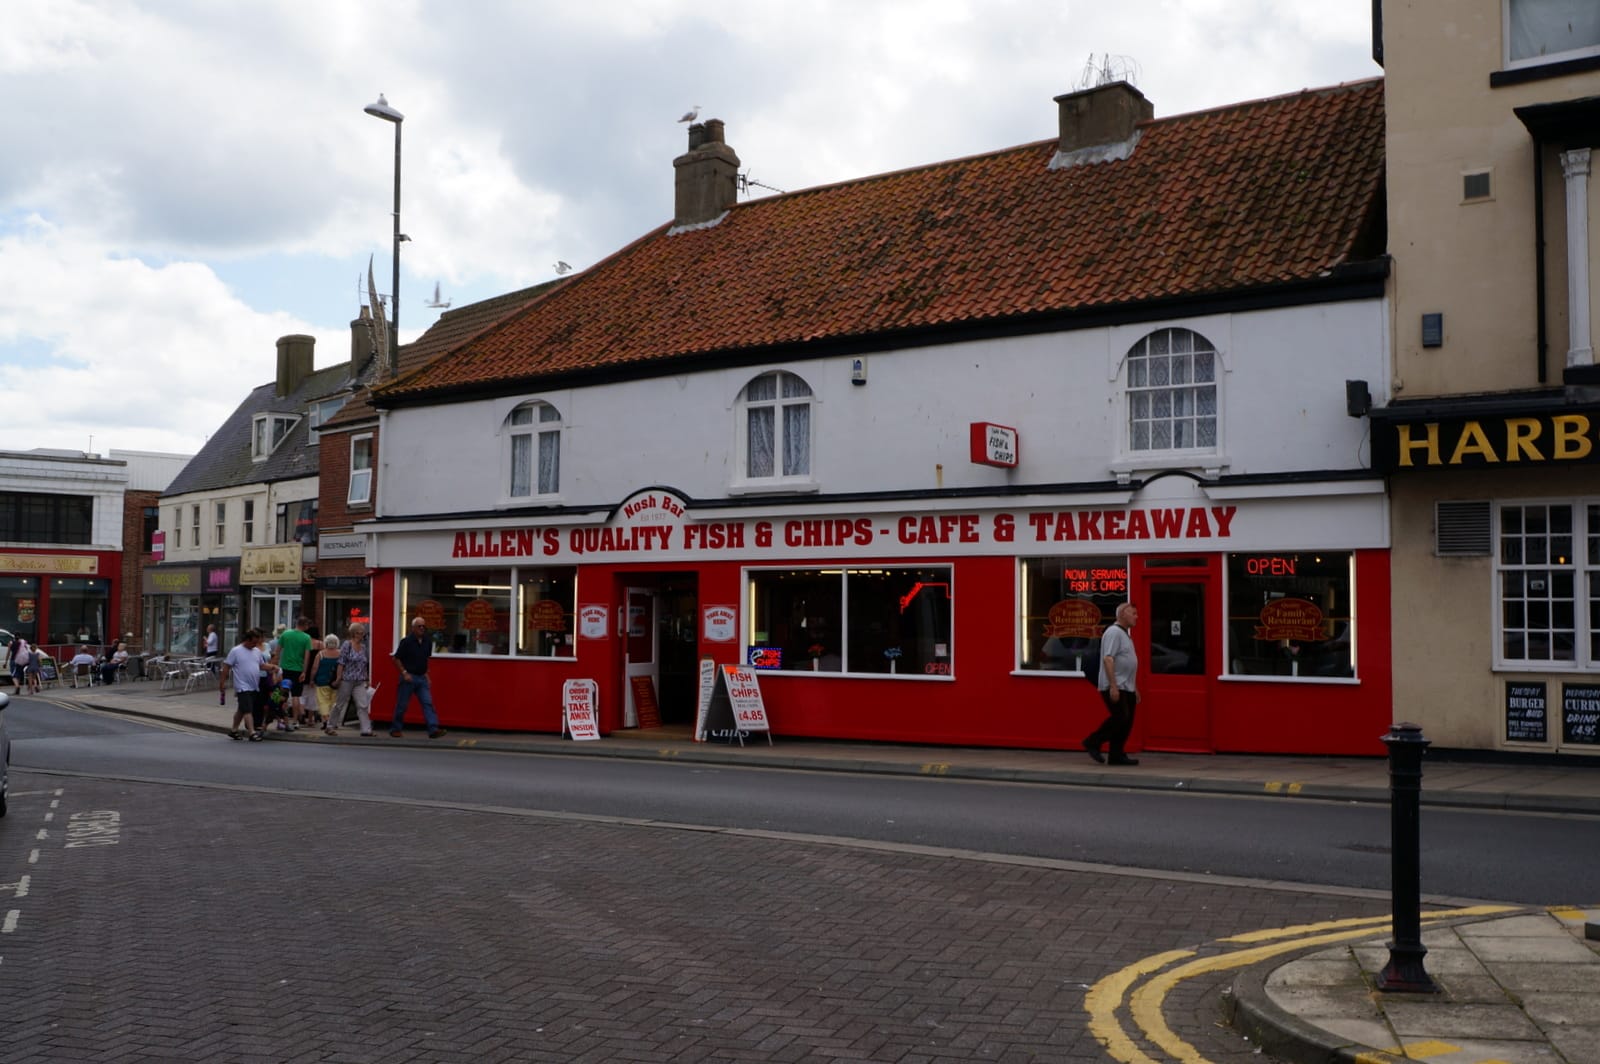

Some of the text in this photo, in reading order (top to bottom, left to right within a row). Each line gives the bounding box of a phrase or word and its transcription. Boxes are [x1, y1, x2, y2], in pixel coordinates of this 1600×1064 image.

[1397, 414, 1600, 467] HARB
[624, 494, 684, 519] Nosh Bar
[452, 529, 560, 558] ALLEN'S
[570, 525, 673, 555] QUALITY
[683, 522, 745, 550] FISH
[755, 522, 773, 547] &
[784, 518, 873, 547] CHIPS
[898, 514, 980, 544] CAFE
[993, 513, 1015, 542] &
[1029, 506, 1237, 542] TAKEAWAY
[1246, 556, 1296, 576] OPEN
[1064, 567, 1128, 580] NOW SERVING
[1070, 580, 1089, 592] FISH
[1100, 579, 1126, 591] CHIPS
[706, 611, 719, 621] TAKE
[1276, 608, 1307, 618] Family
[1054, 616, 1097, 625] Restaurant
[1267, 615, 1317, 626] Restaurant
[925, 661, 951, 674] OPEN
[730, 673, 752, 682] FISH
[731, 688, 759, 698] CHIPS
[568, 703, 590, 711] TAKE
[1509, 697, 1545, 709] BURGER
[570, 712, 591, 721] AWAY
[1566, 713, 1600, 724] DRINK
[571, 724, 594, 732] INSIDE
